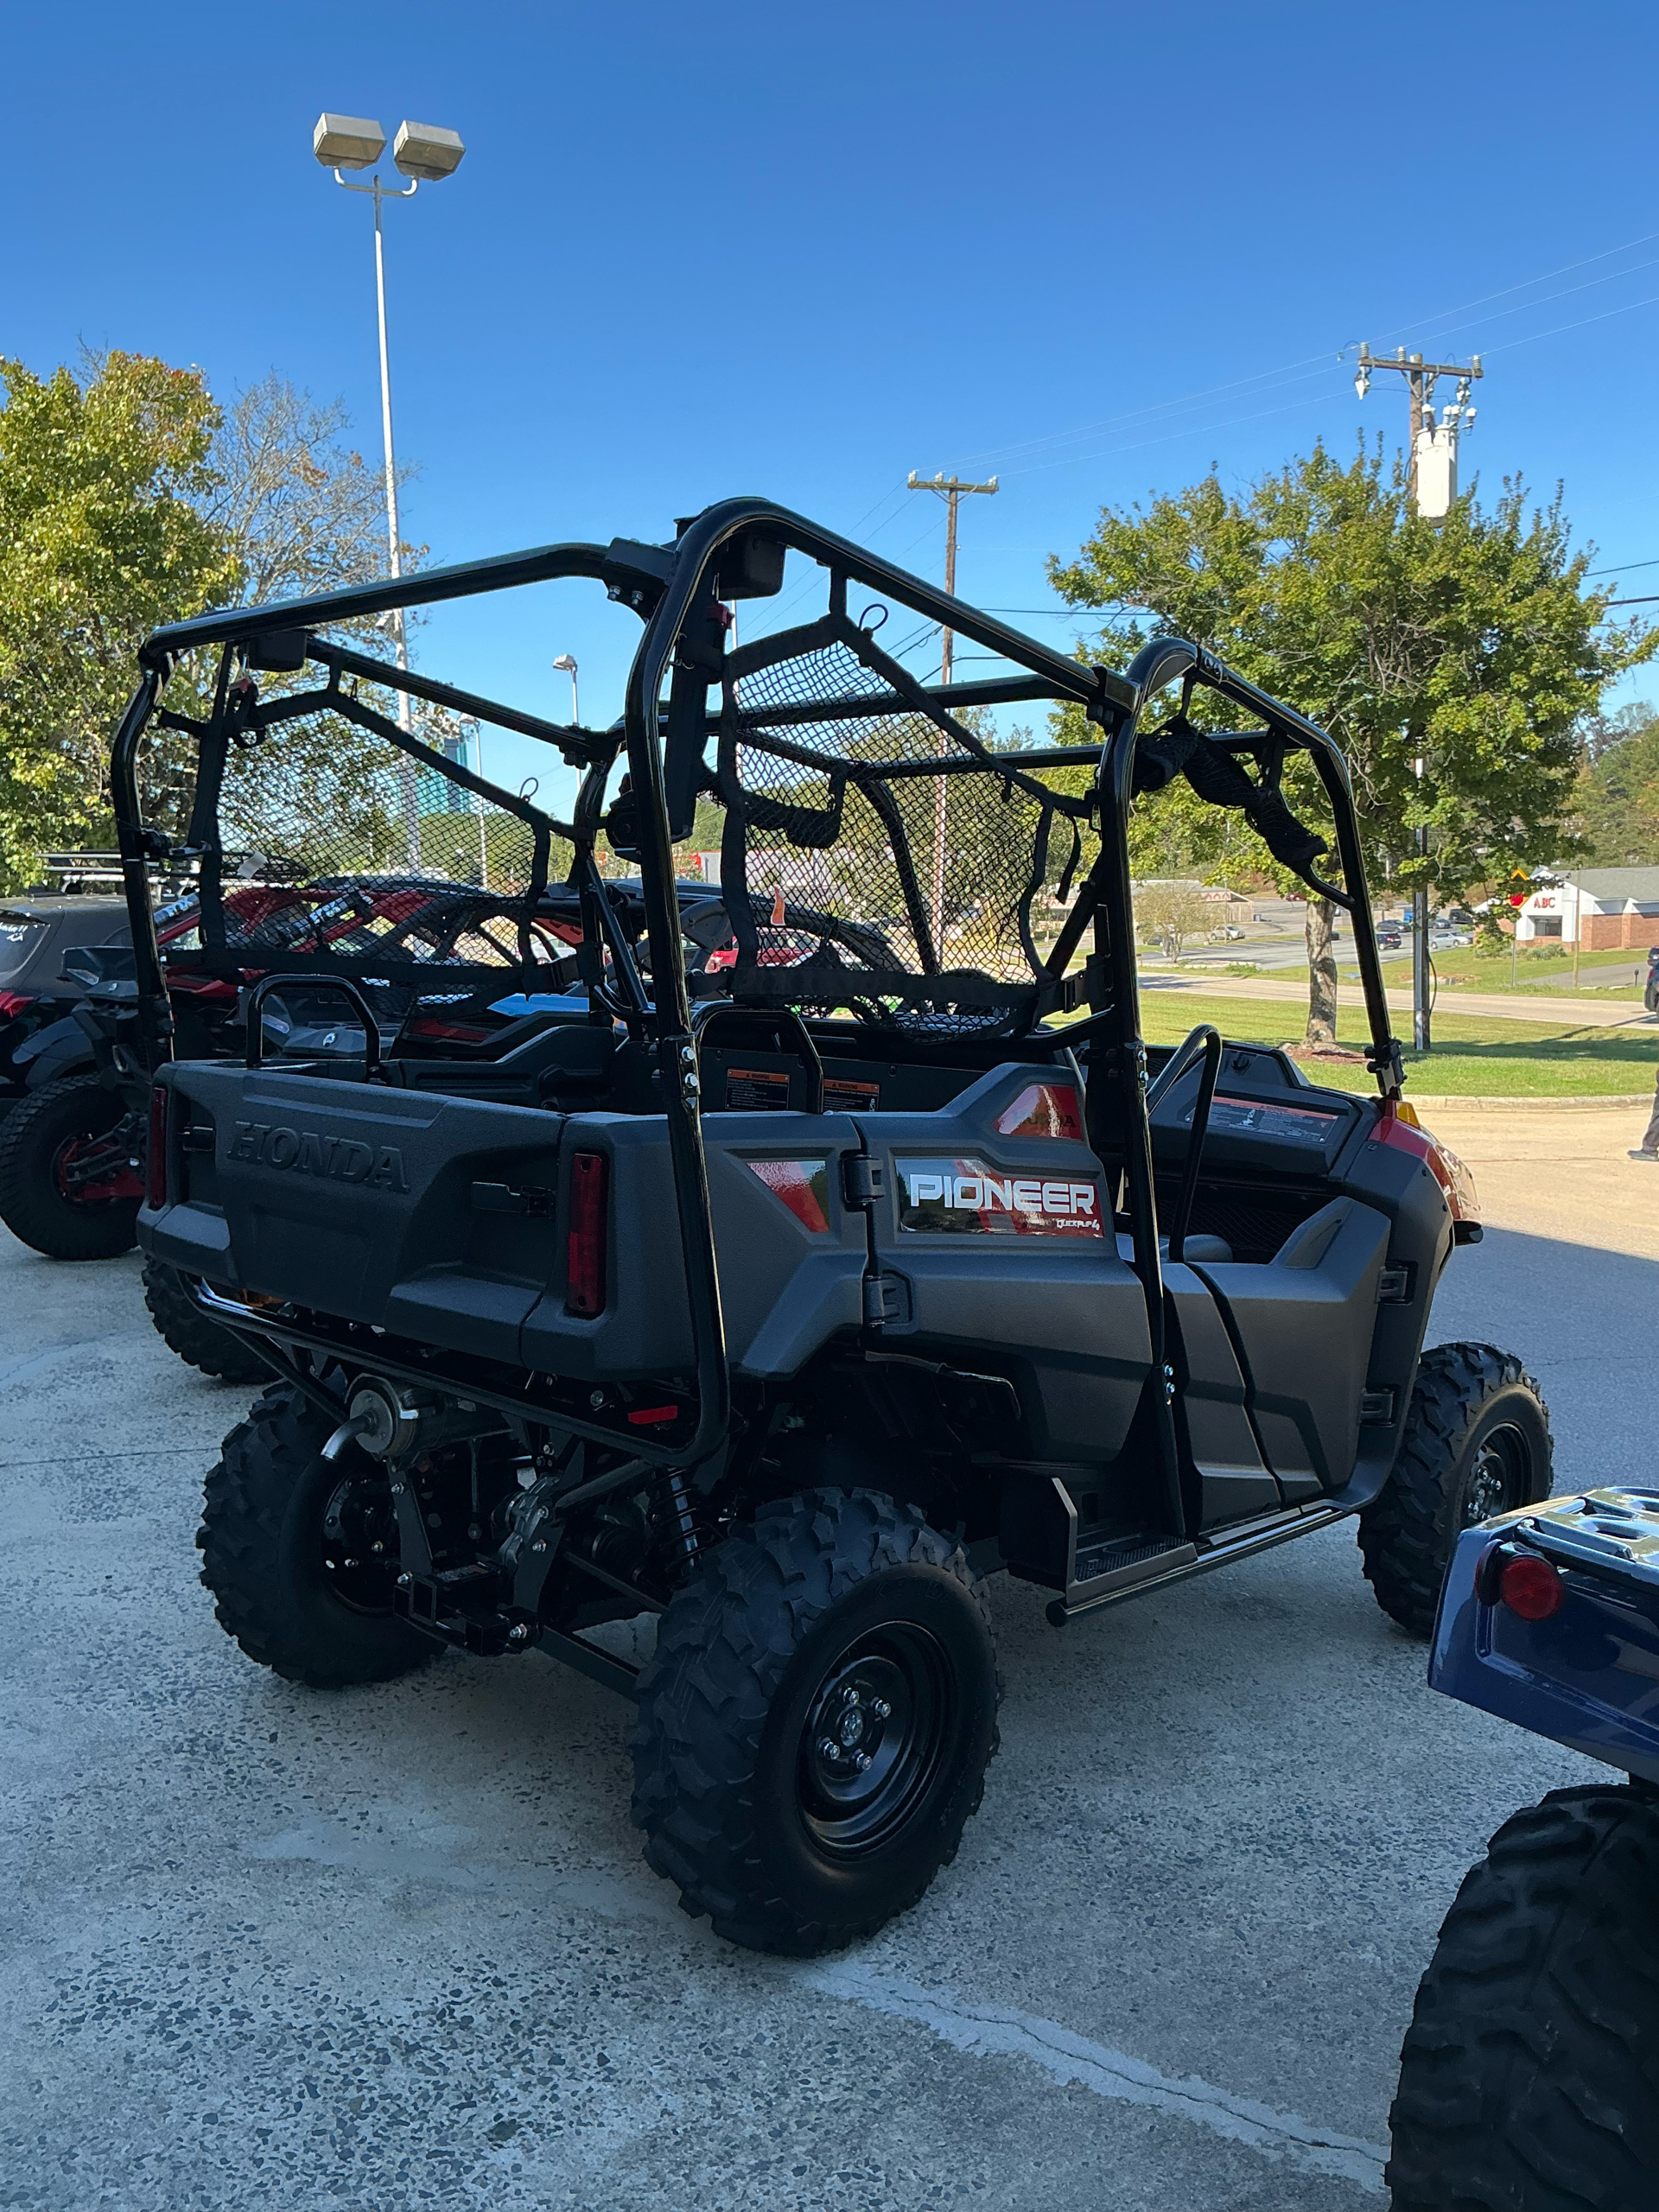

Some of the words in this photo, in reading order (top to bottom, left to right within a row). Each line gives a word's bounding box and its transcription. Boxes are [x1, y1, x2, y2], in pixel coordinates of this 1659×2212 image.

[1534, 897, 1556, 909] ABC
[226, 1121, 410, 1193] HONDA
[909, 1173, 1096, 1215] PIONEER
